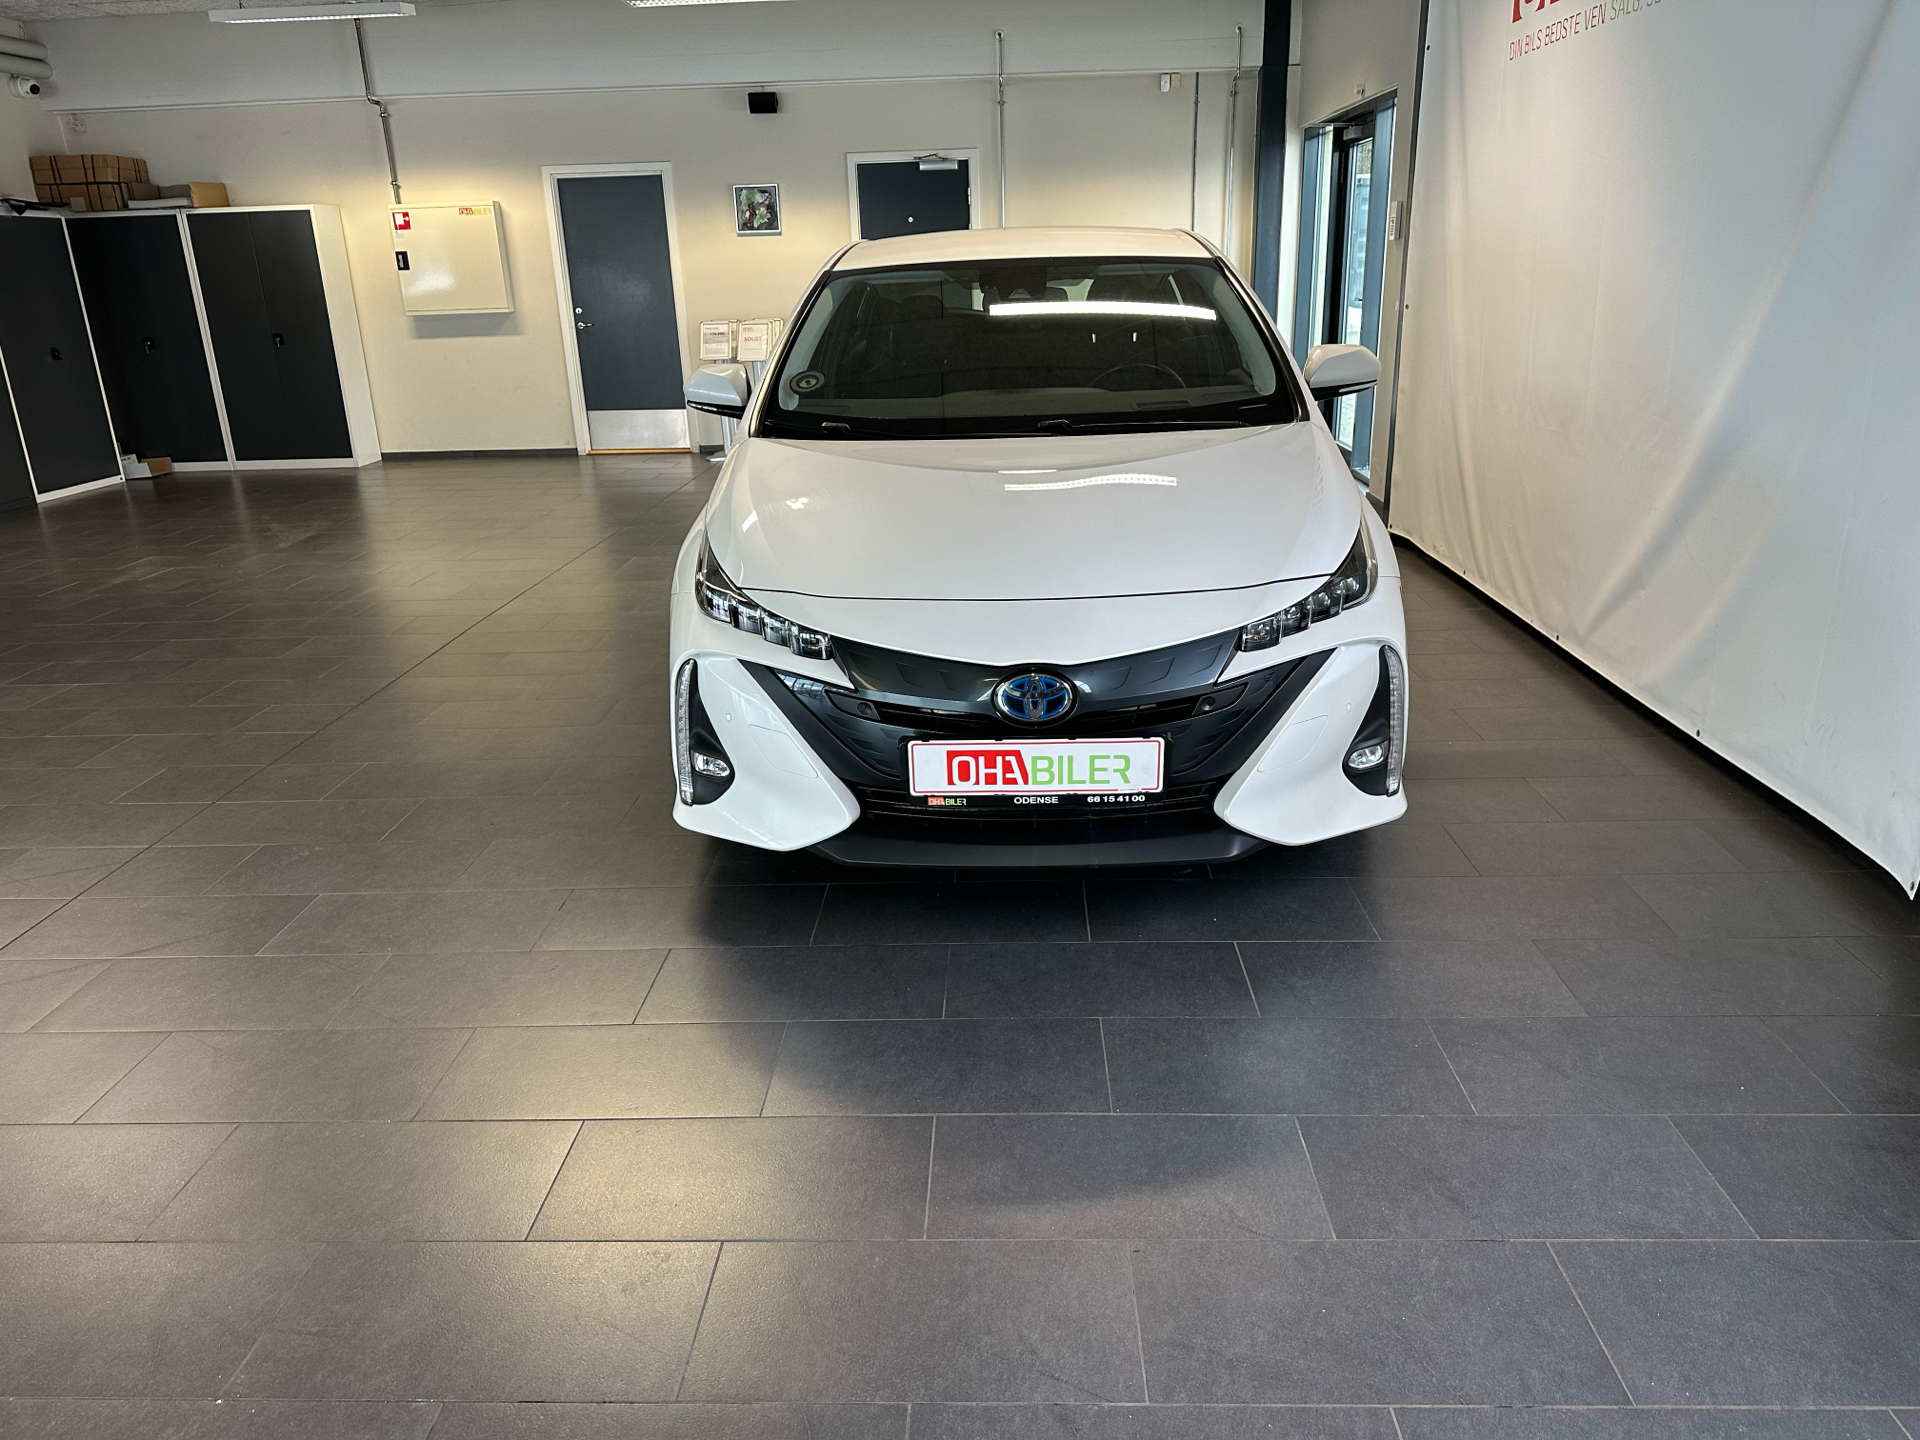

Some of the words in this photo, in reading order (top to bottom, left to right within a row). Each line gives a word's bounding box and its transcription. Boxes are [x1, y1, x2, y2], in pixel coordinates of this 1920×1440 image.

[1509, 38, 1523, 60] DIN
[1524, 29, 1543, 54] BILS
[1544, 12, 1582, 46] BEDSTE
[1584, 2, 1607, 31] VEN
[1013, 796, 1059, 804] ODENSE
[1086, 795, 1101, 803] 66
